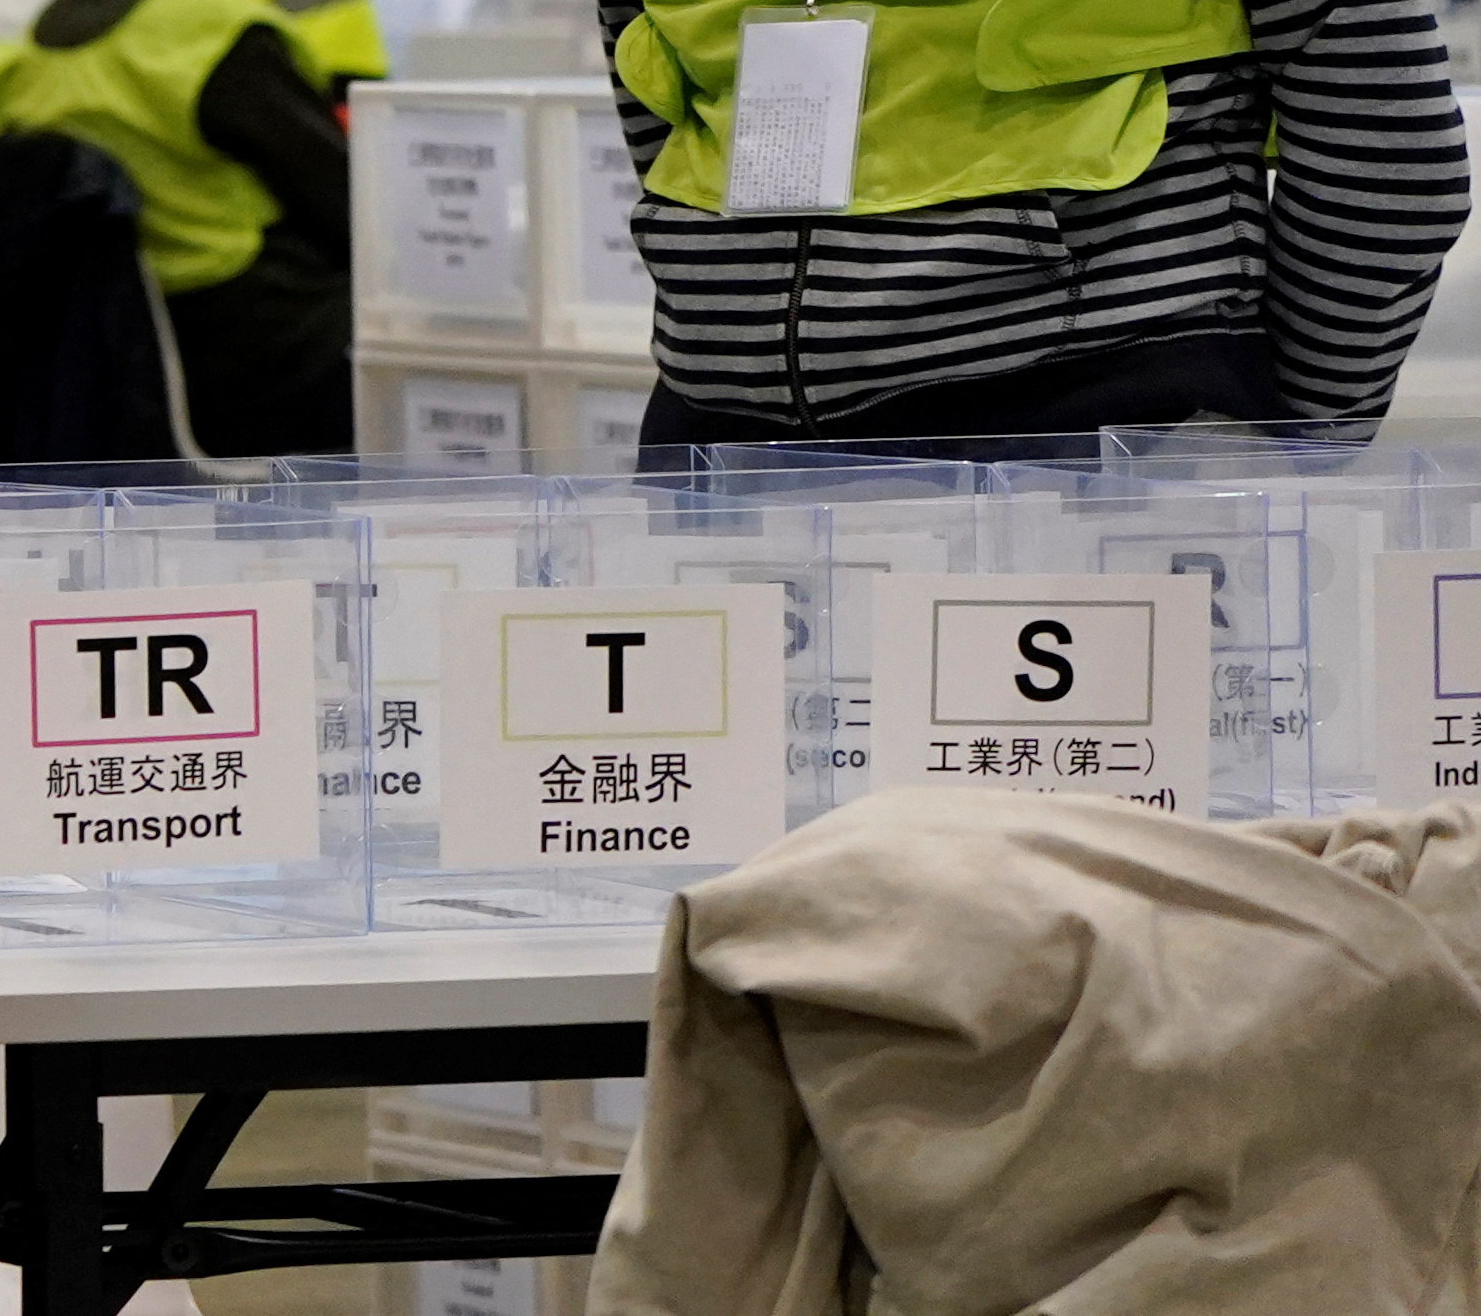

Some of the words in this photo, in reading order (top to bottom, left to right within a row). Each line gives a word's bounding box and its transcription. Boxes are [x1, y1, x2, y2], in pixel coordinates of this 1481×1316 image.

[77, 633, 215, 720] TR
[586, 632, 646, 714] T
[1014, 619, 1074, 702] S
[45, 750, 249, 800] 航運交通界
[539, 752, 692, 805] 金融界
[53, 804, 243, 849] Transport
[539, 820, 691, 854] Finance
